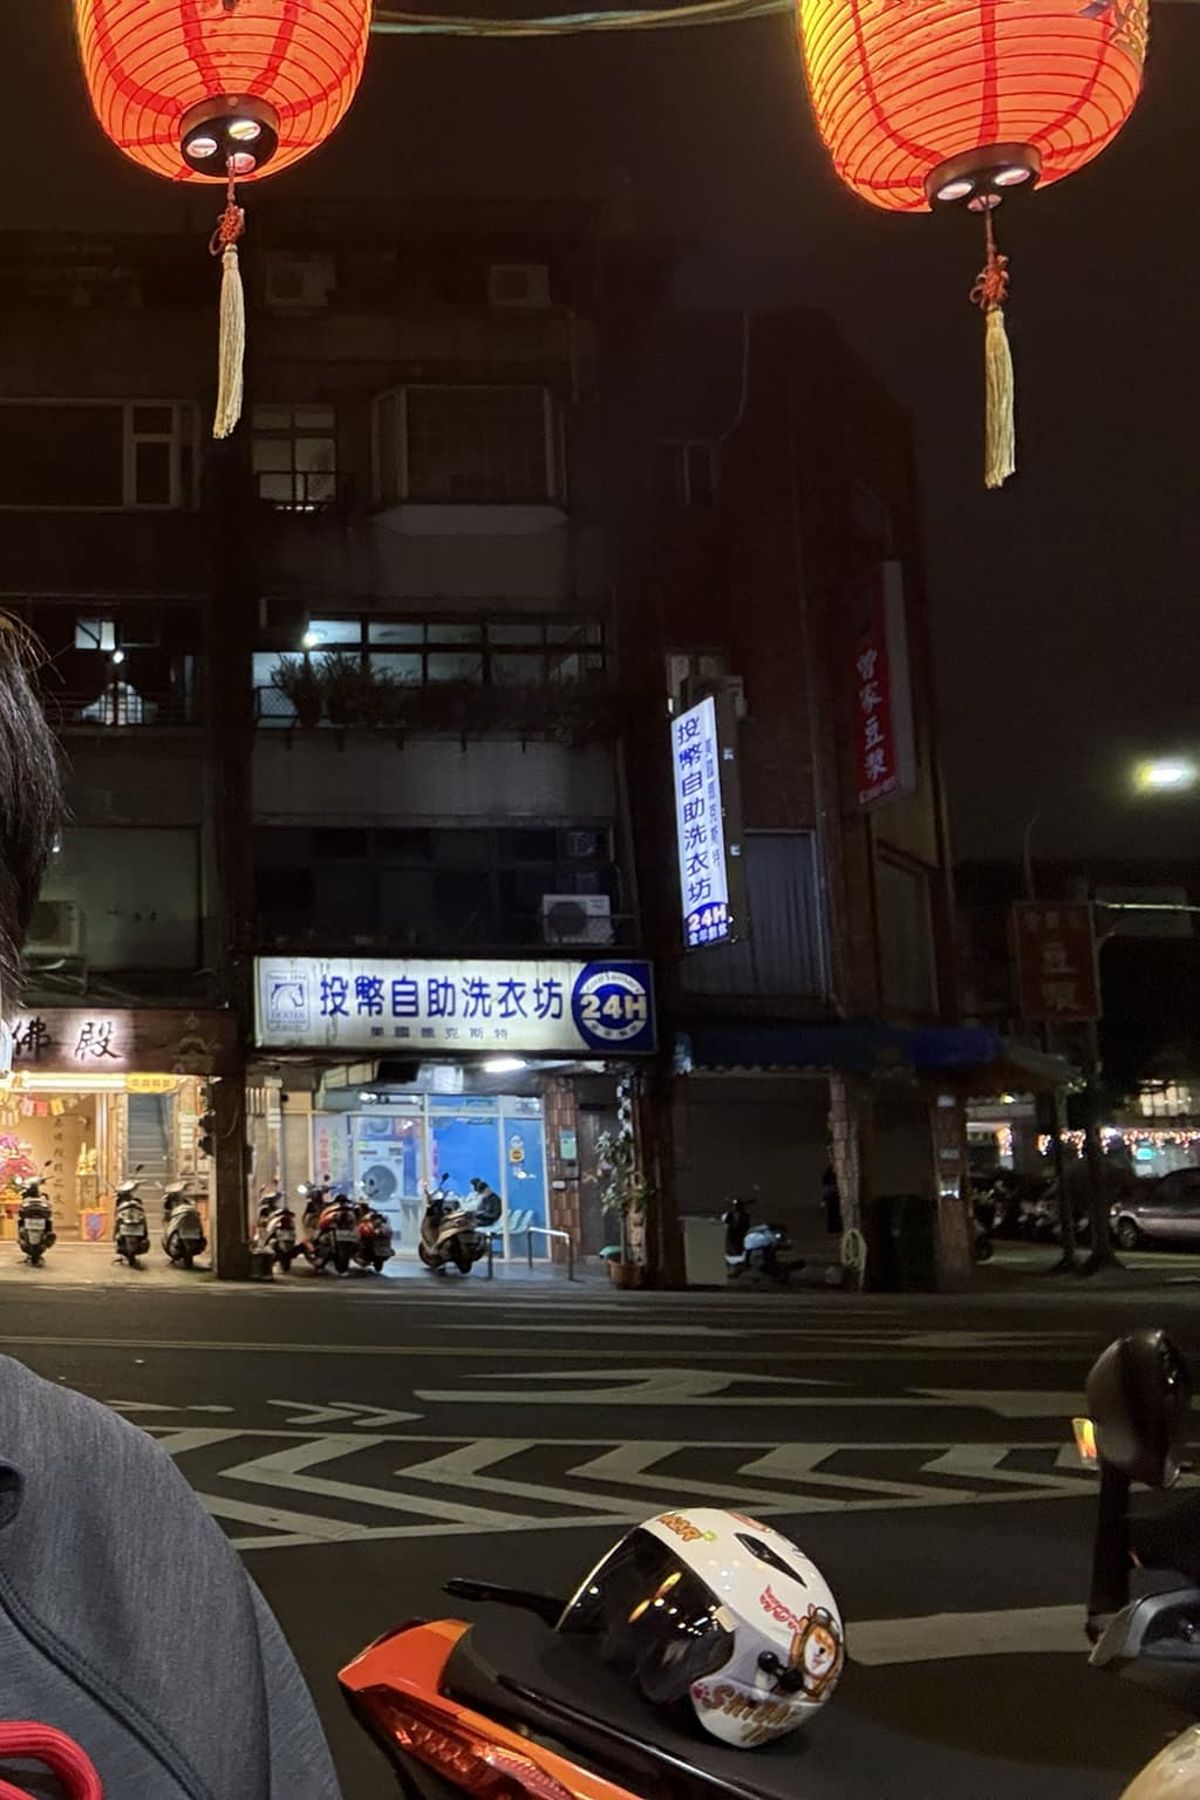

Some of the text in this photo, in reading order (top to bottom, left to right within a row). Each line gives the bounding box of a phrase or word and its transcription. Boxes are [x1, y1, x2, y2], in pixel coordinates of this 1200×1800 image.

[677, 716, 712, 904] 投幣自助洗衣坊
[688, 904, 727, 932] 24H
[319, 974, 563, 1021] 投幣自助洗衣坊
[580, 994, 648, 1020] 24H
[11, 1015, 123, 1060] 佛殿
